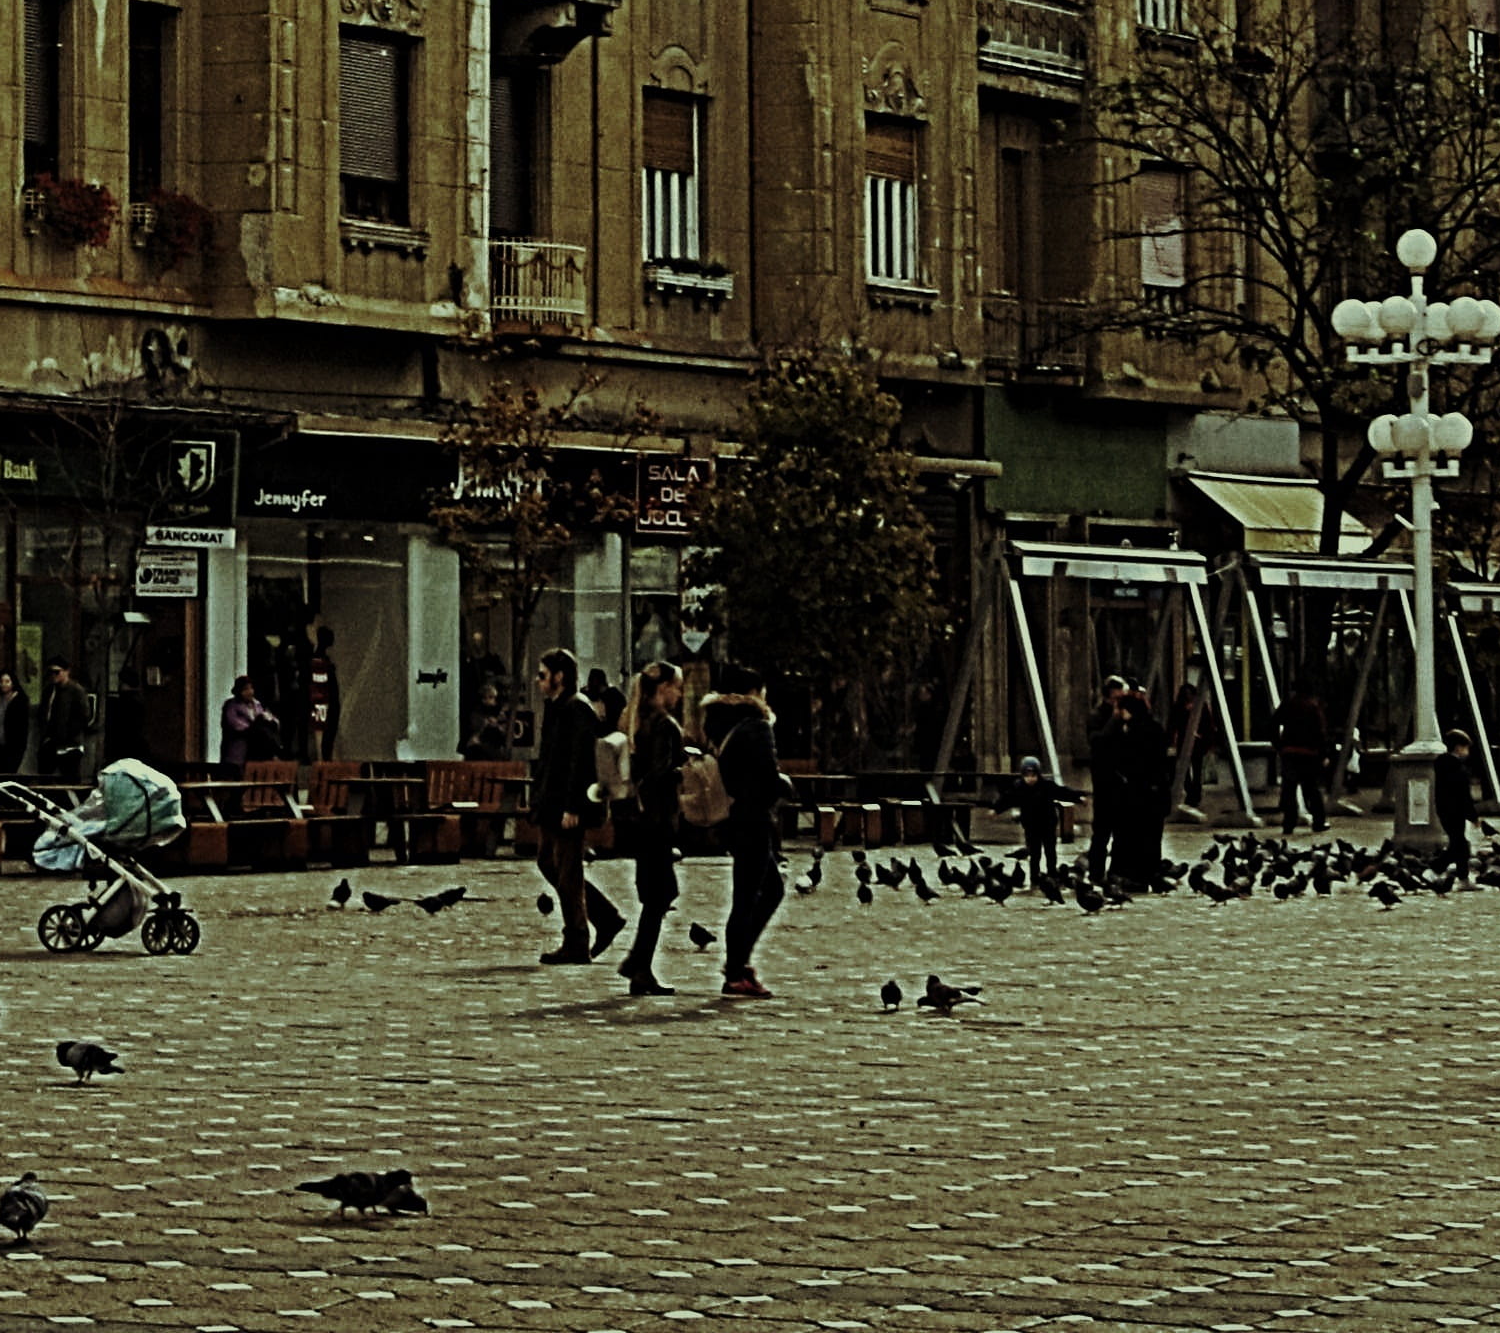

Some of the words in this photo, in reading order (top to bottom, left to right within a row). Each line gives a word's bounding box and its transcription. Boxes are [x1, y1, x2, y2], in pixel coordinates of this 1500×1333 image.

[3, 457, 38, 482] Bank
[648, 465, 701, 483] SALA
[254, 487, 327, 512] Jennyfer
[660, 486, 687, 503] DE
[155, 530, 224, 544] BANCOMAT
